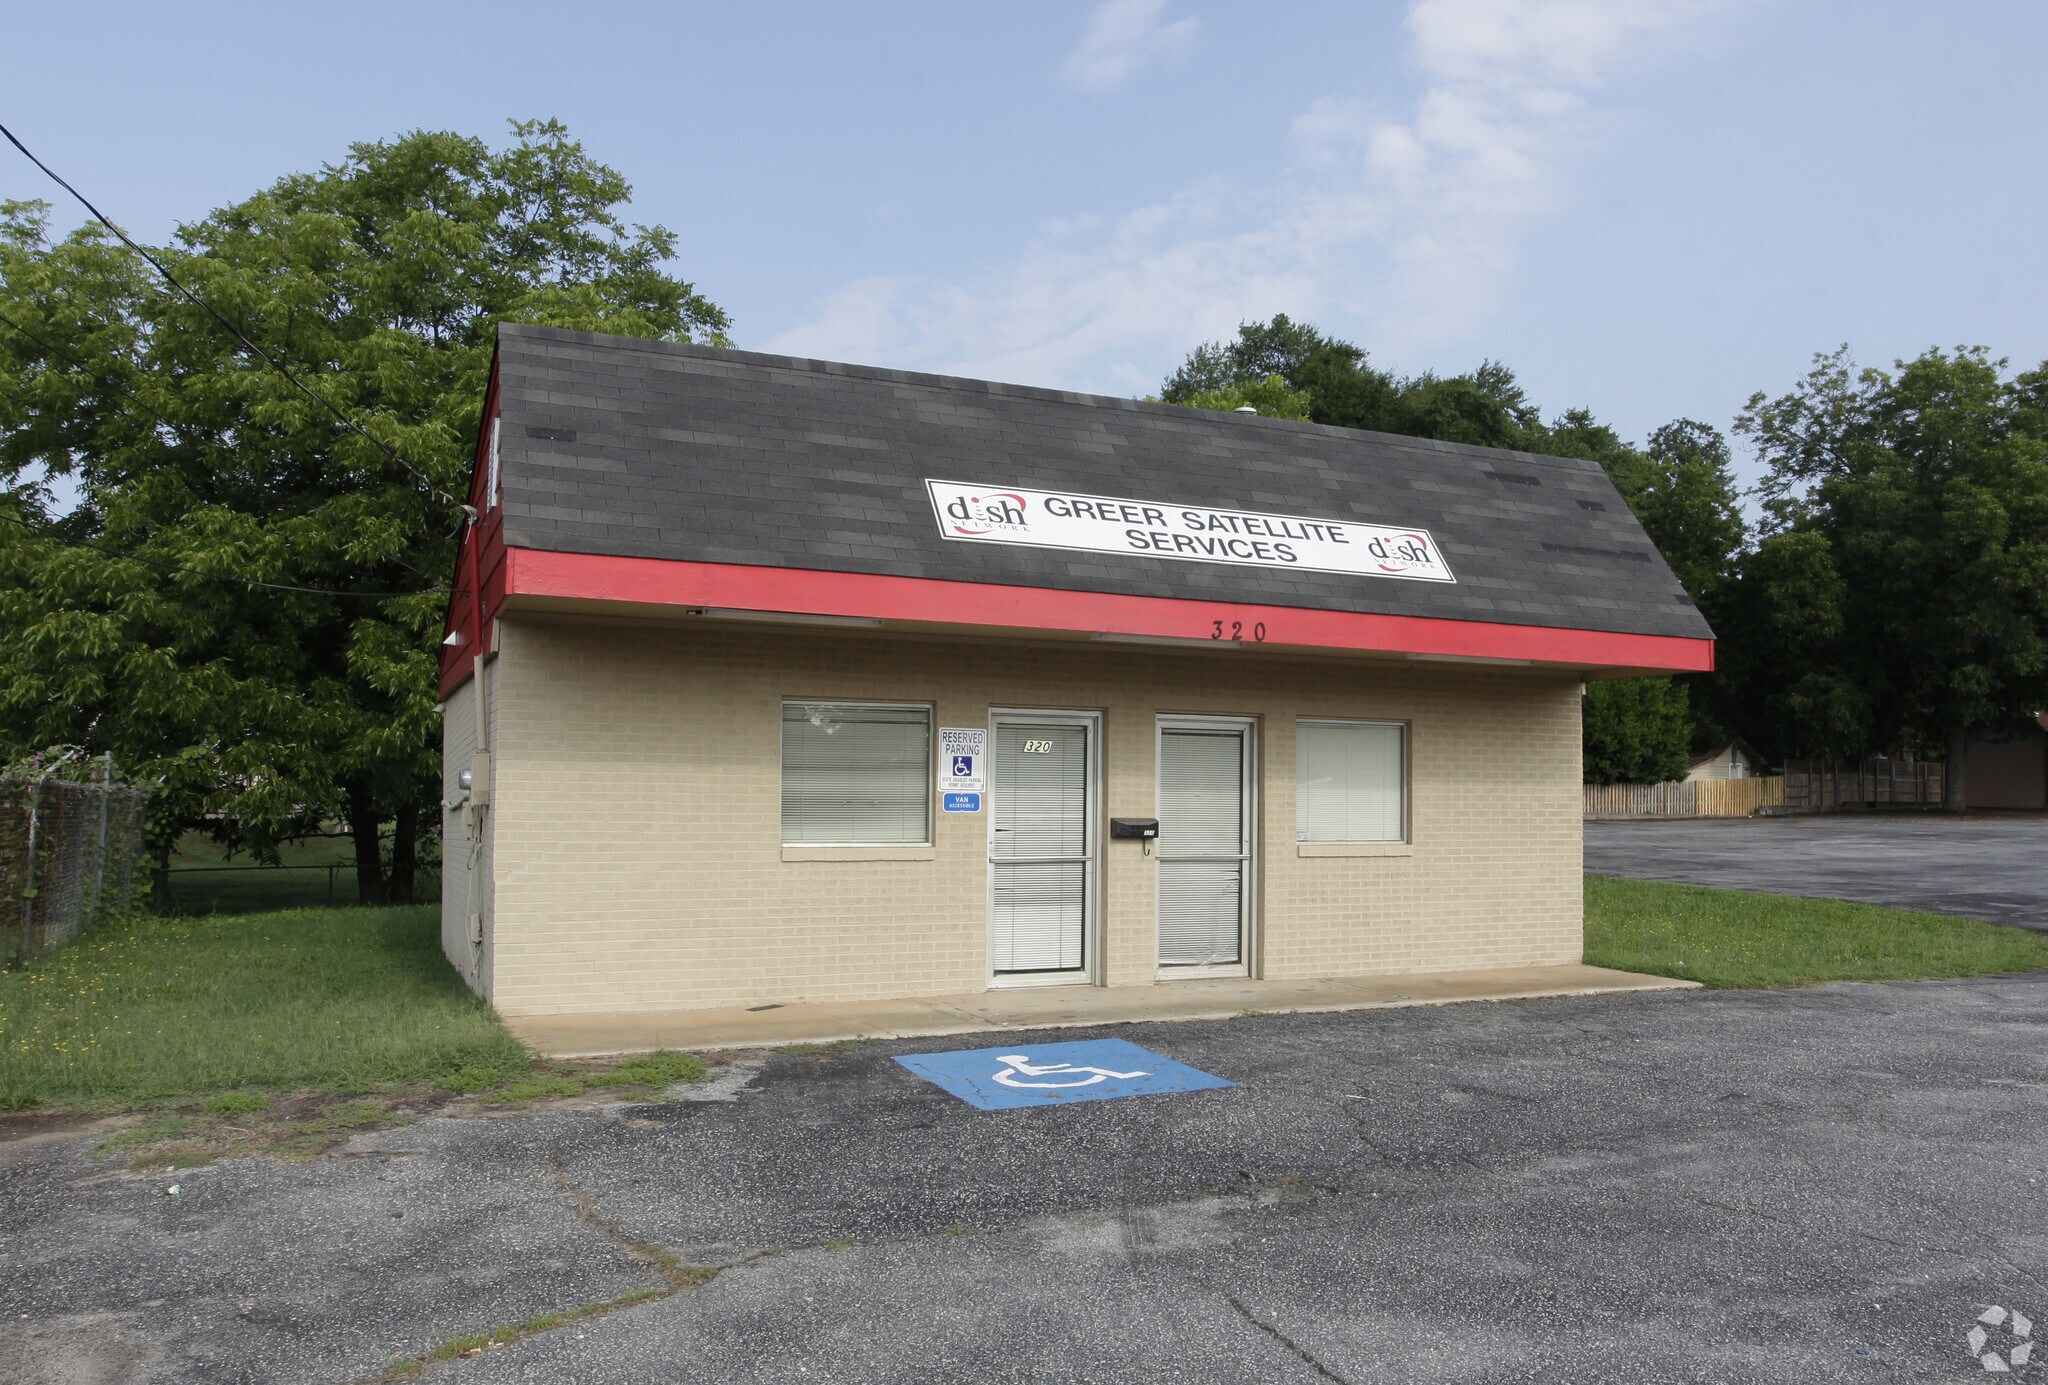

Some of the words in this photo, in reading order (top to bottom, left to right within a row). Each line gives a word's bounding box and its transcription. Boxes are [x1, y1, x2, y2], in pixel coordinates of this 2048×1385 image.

[951, 519, 1031, 533] NETWORK
[1043, 497, 1168, 527] GREER
[1181, 511, 1350, 544] SATELLITE
[1125, 529, 1298, 563] SERVICES
[1374, 558, 1438, 570] NETWORK
[1211, 620, 1266, 643] 320
[942, 731, 983, 744] RESERVED
[945, 744, 980, 755] PARKING
[1026, 741, 1050, 752] 320
